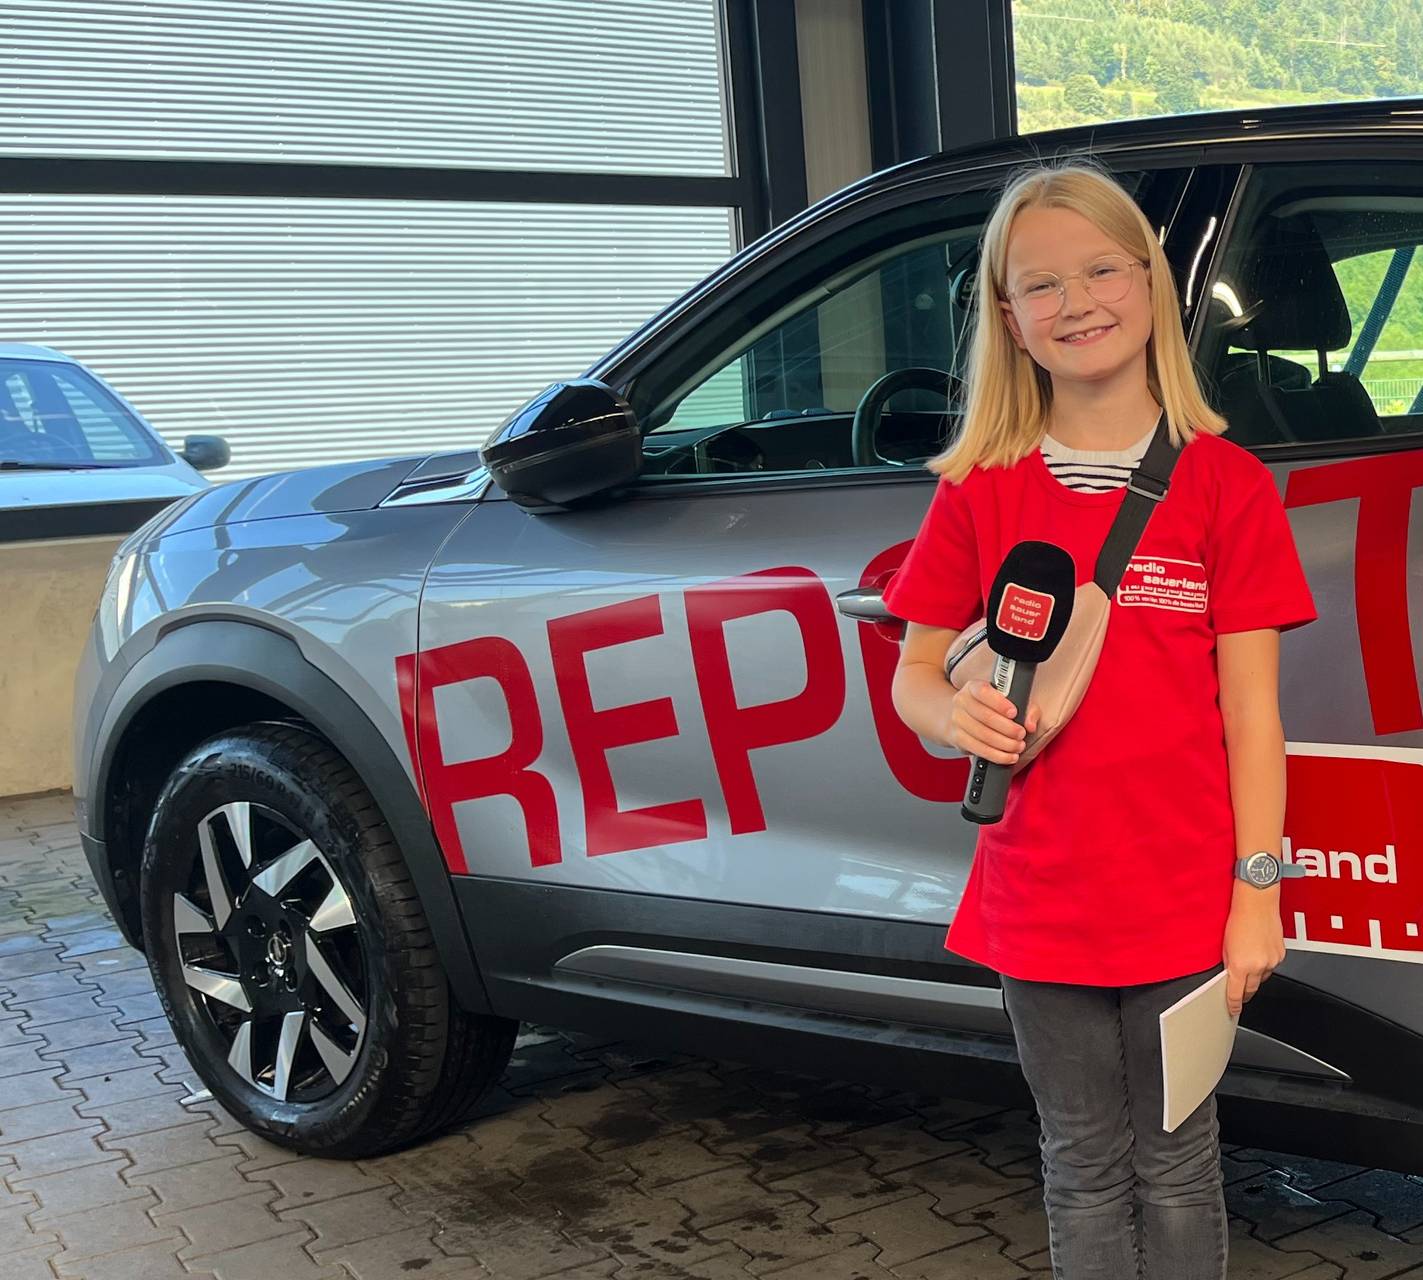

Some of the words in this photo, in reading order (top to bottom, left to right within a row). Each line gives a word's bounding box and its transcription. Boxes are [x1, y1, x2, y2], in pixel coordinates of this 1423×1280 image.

[1126, 562, 1166, 574] radio
[1143, 575, 1207, 591] sauerland
[1014, 596, 1042, 609] radio
[1010, 604, 1041, 617] sauer
[1011, 612, 1035, 625] land
